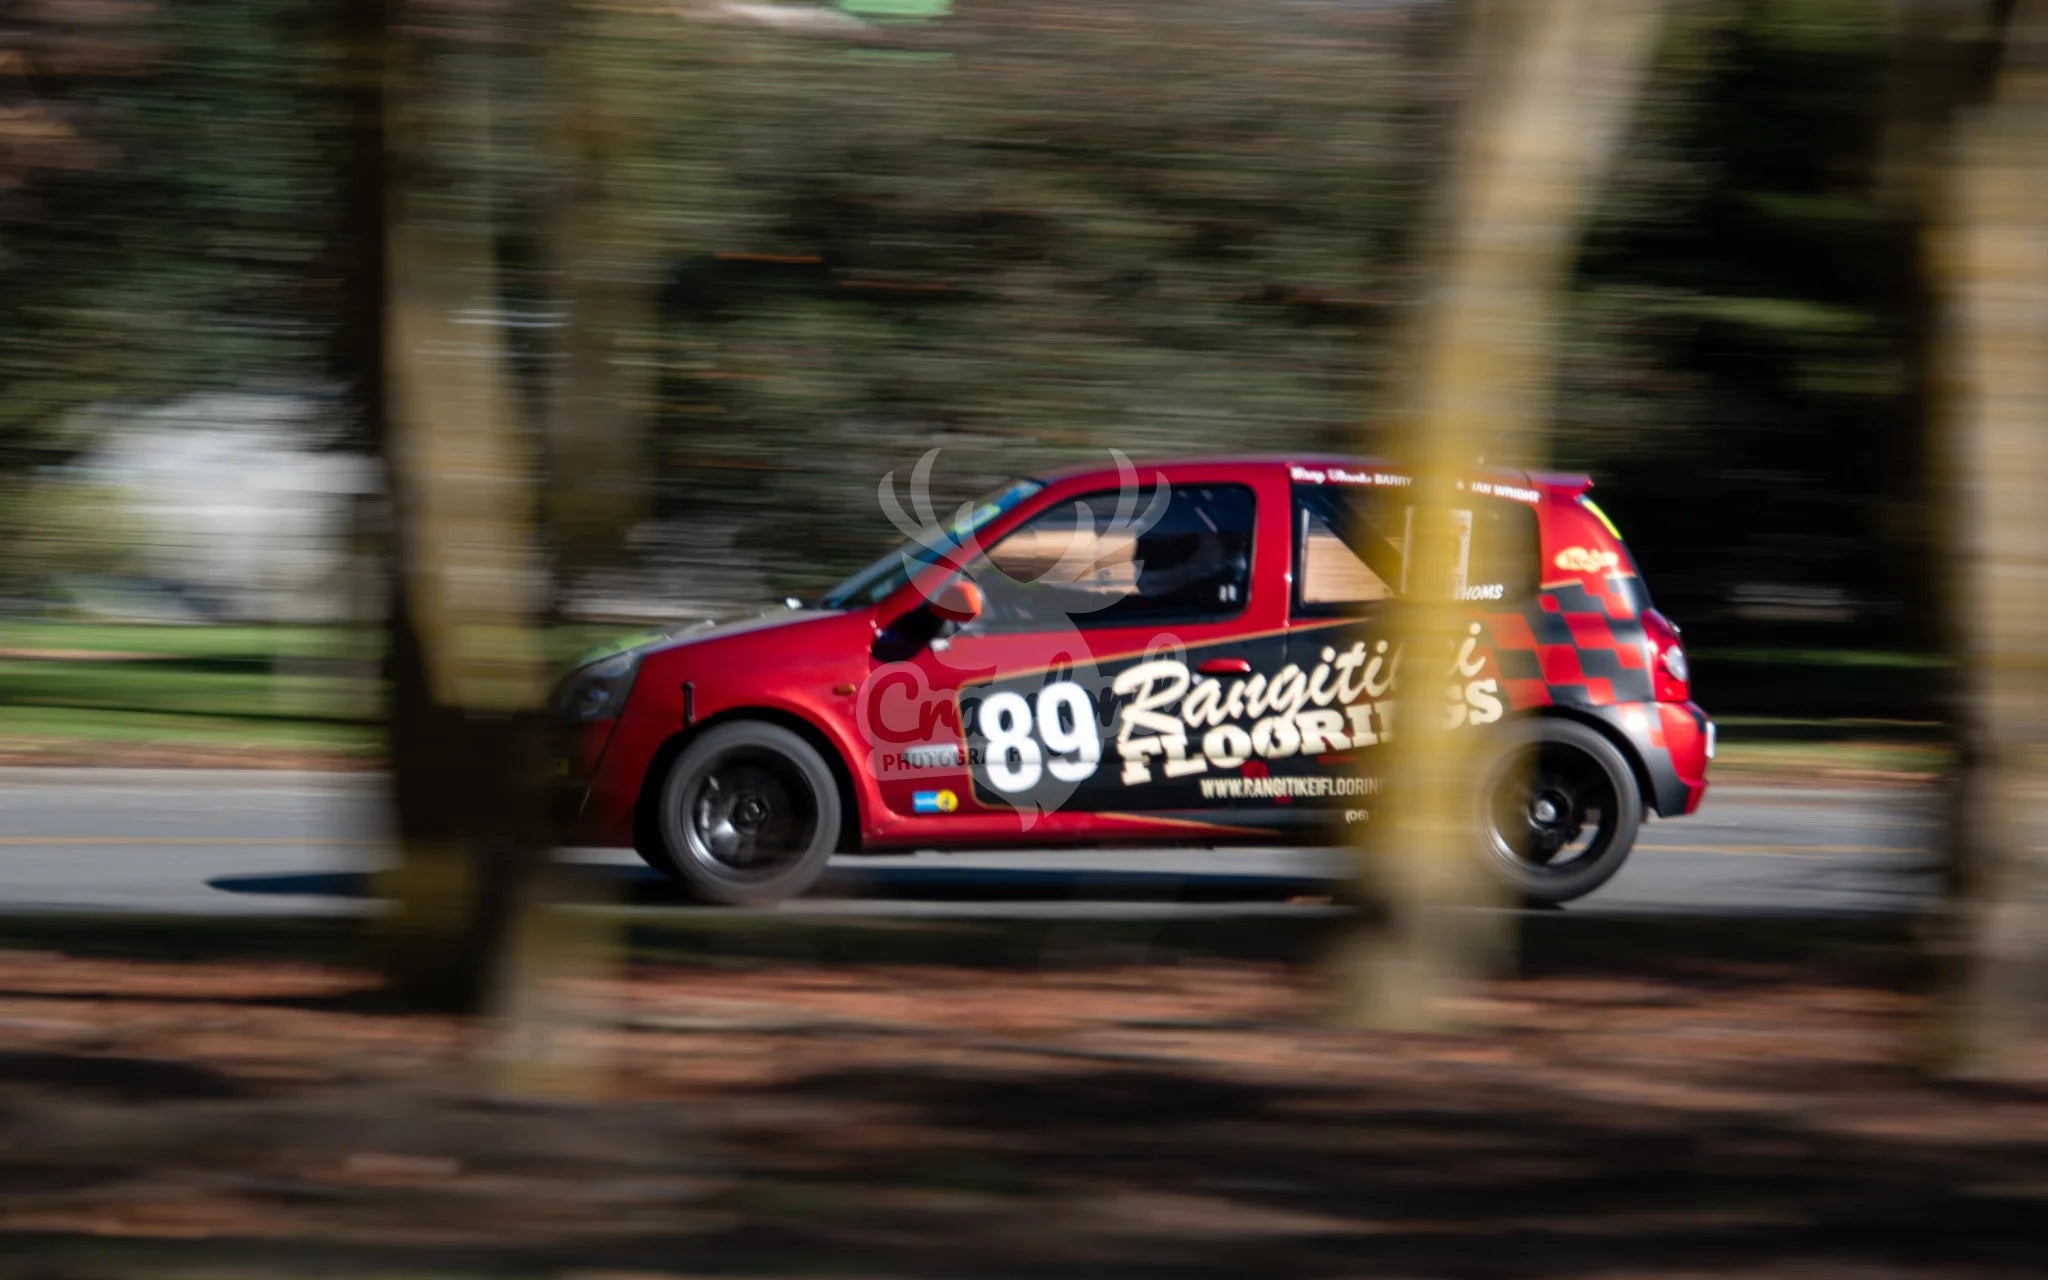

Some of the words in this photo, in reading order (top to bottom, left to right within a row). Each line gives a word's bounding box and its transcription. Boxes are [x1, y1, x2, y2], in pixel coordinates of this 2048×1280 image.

[1375, 473, 1413, 487] BARRY
[1472, 482, 1492, 494] IAN
[1493, 485, 1541, 503] WRIGHT
[1455, 584, 1503, 601] HOMS
[979, 681, 1101, 793] 89
[1113, 622, 1487, 745] Rangitii
[1117, 678, 1503, 786] FLOORIGS
